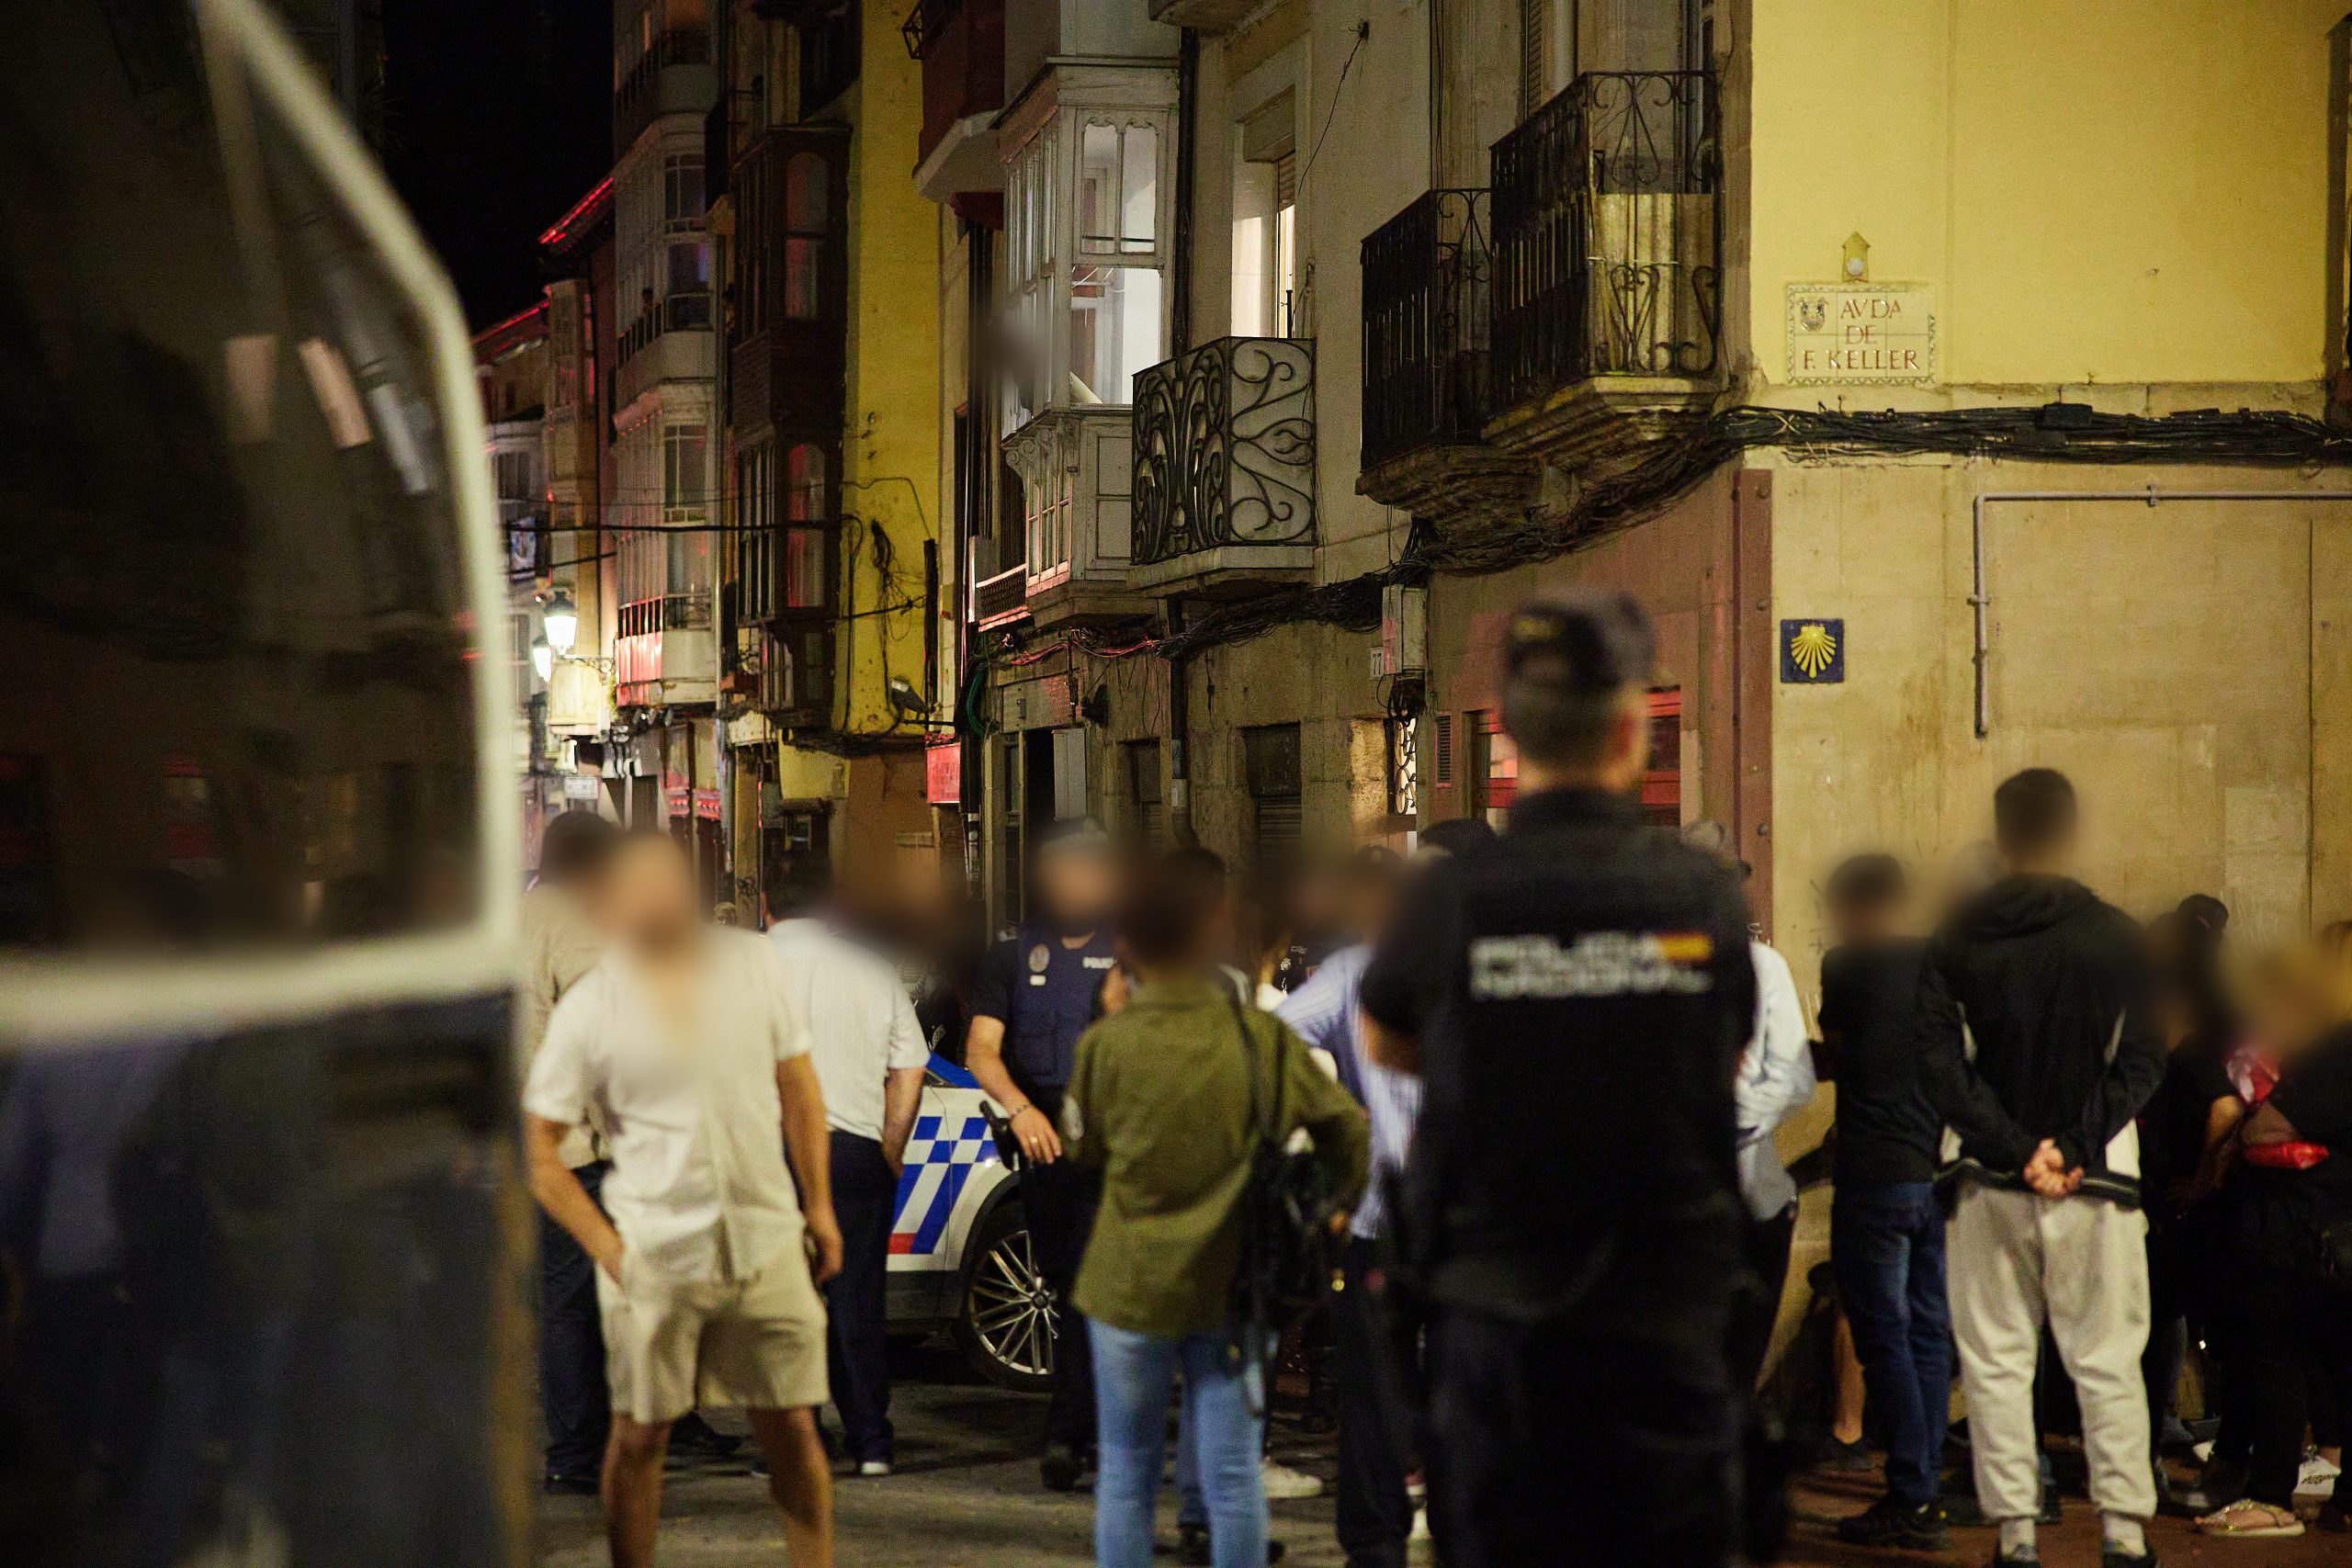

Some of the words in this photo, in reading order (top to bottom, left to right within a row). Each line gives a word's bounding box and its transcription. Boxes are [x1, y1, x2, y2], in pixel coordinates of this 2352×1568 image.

[1840, 299, 1902, 320] AVDA
[1845, 324, 1877, 345] DE
[1804, 349, 1816, 371] F.
[1828, 349, 1919, 370] KELLER
